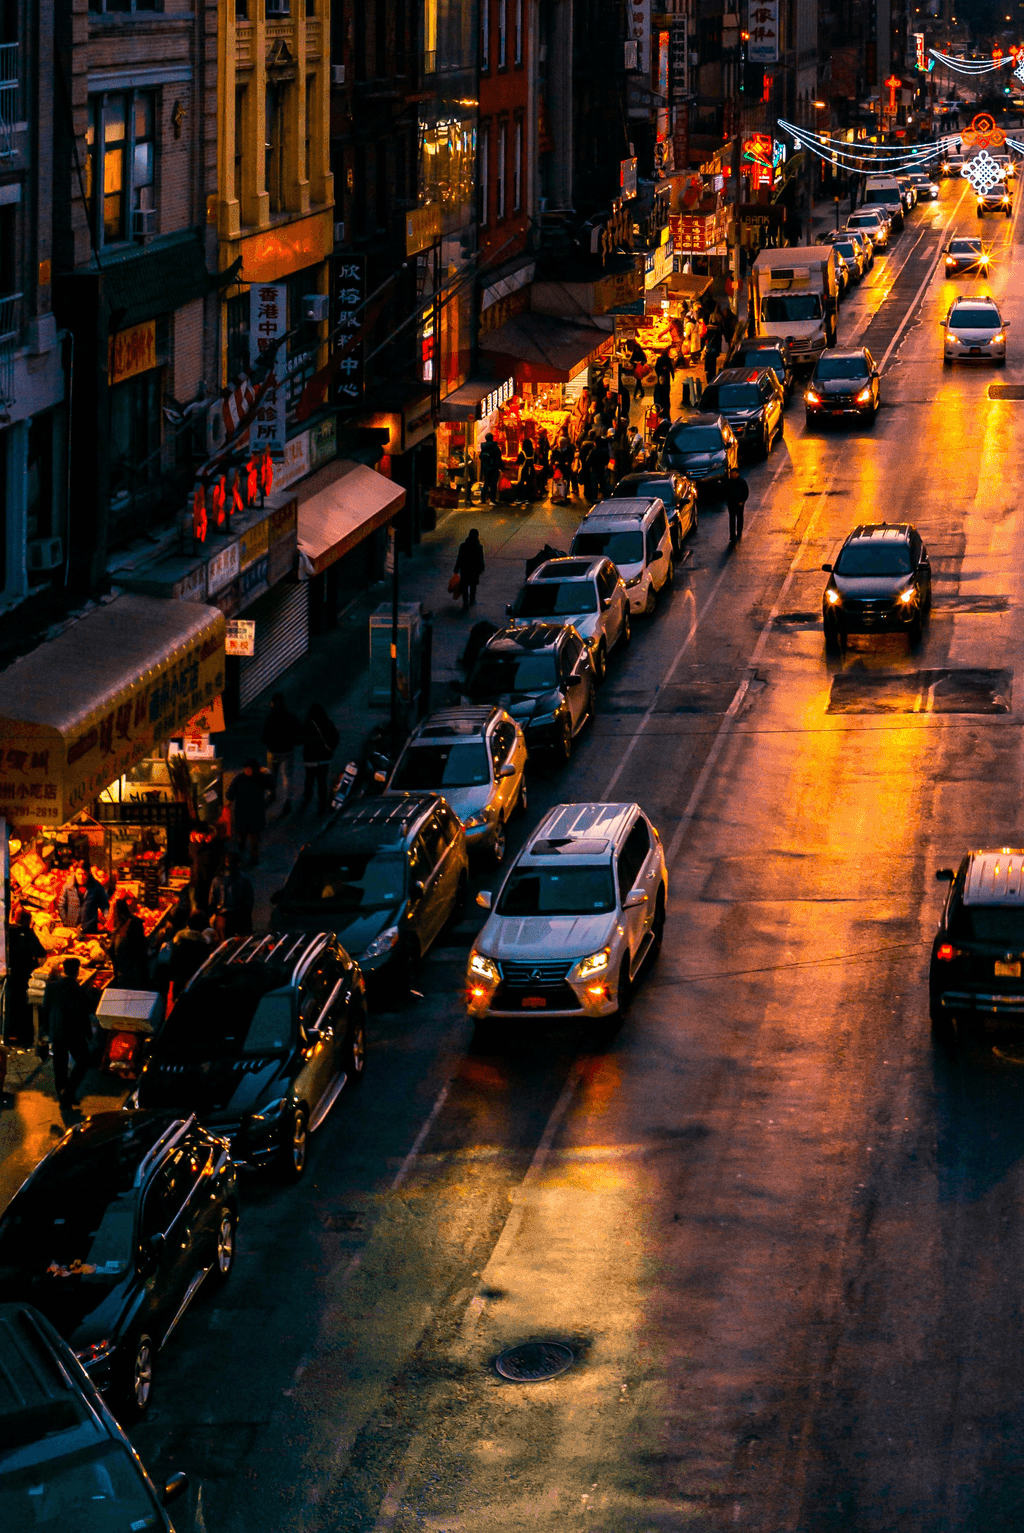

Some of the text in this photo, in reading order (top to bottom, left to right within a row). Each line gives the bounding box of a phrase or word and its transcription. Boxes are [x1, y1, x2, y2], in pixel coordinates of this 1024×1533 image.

[745, 215, 770, 224] BANK
[0, 782, 57, 800] 州小吃店
